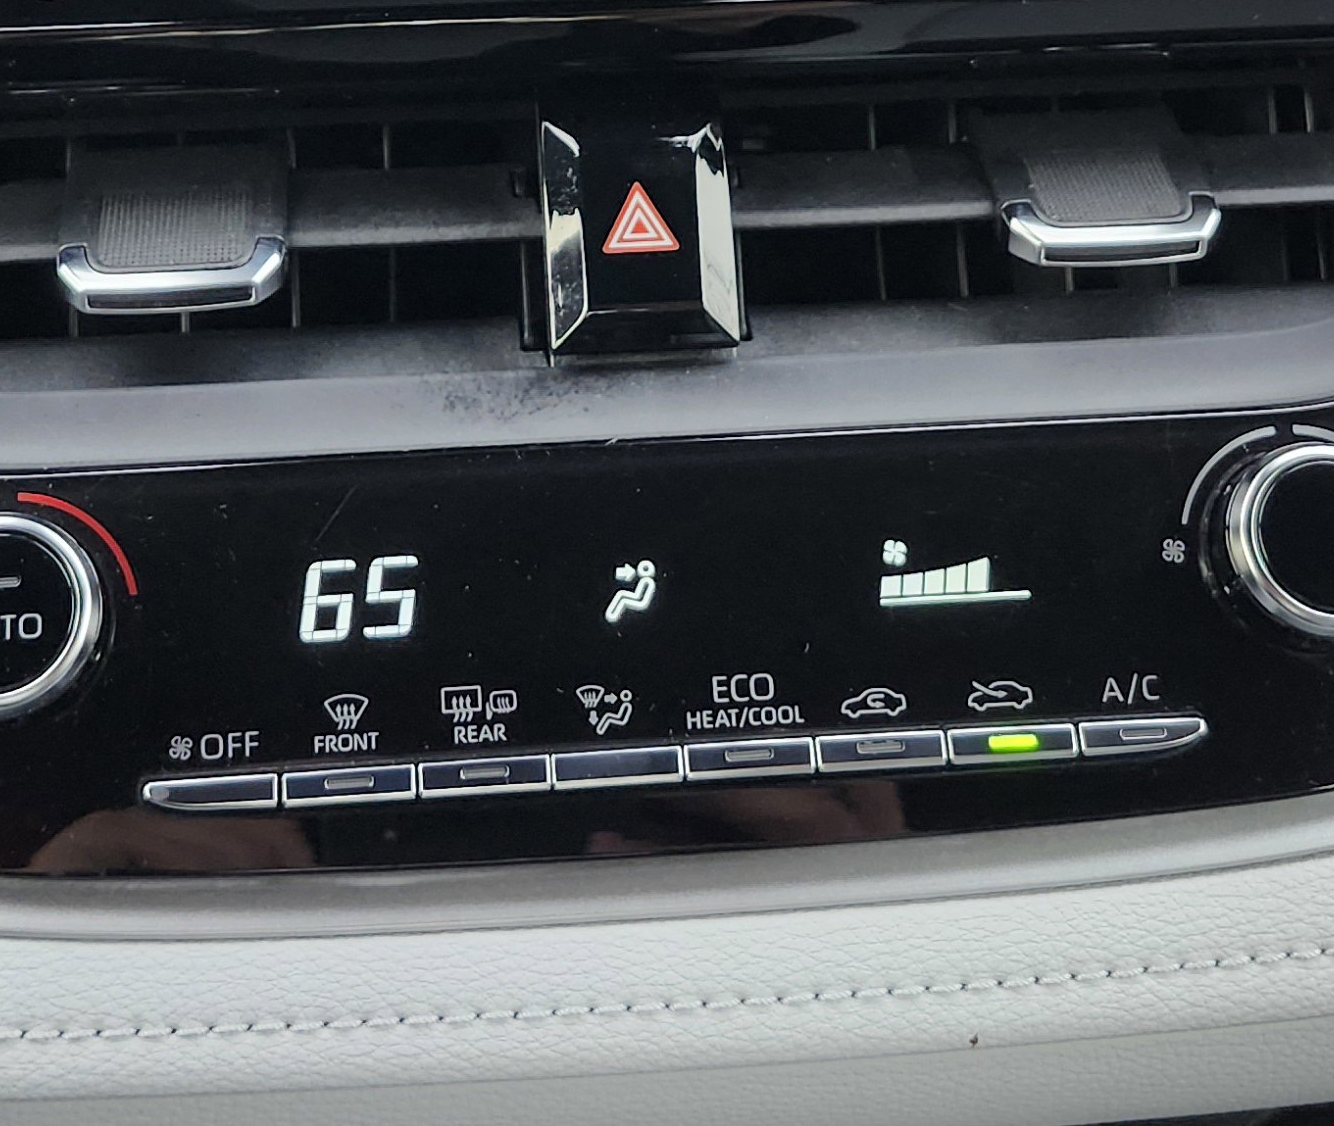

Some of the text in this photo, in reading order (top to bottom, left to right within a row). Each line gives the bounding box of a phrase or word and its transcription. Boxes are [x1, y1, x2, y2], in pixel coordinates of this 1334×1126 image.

[298, 555, 419, 643] 65
[711, 674, 775, 704] ECO
[1102, 674, 1160, 704] A/C
[686, 704, 805, 730] HEAT/COOL
[200, 730, 260, 760] OFF
[314, 731, 379, 754] FRONT
[453, 722, 506, 744] REAR
